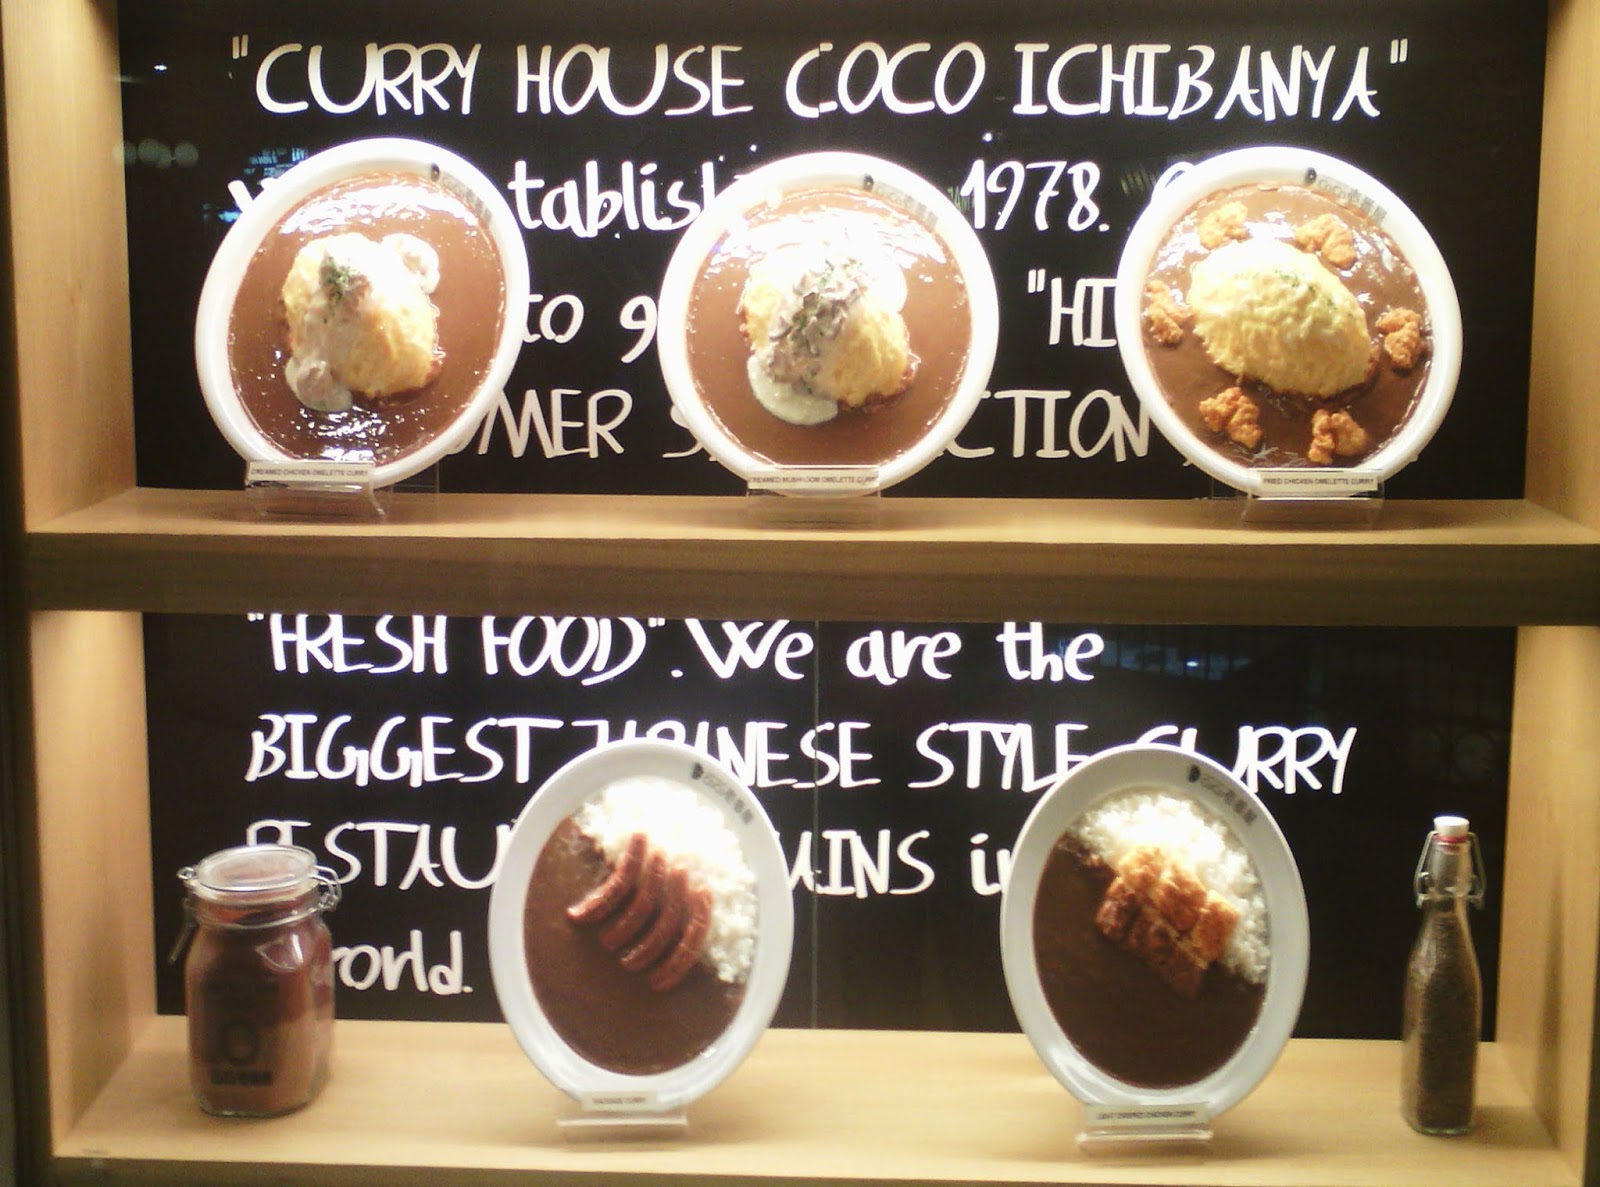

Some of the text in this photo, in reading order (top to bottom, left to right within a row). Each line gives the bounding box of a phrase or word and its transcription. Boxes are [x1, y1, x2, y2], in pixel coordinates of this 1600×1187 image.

[514, 42, 754, 117] HOUSE
[785, 41, 986, 119] COCO
[960, 159, 1111, 232] 1978.
[447, 388, 633, 459] MER
[683, 618, 815, 680] We
[846, 630, 962, 686] are
[995, 621, 1105, 682] the
[244, 713, 1357, 794] BIGGEST NESE STYLE RRY
[774, 829, 936, 899] AINS
[331, 928, 474, 996] orld.
